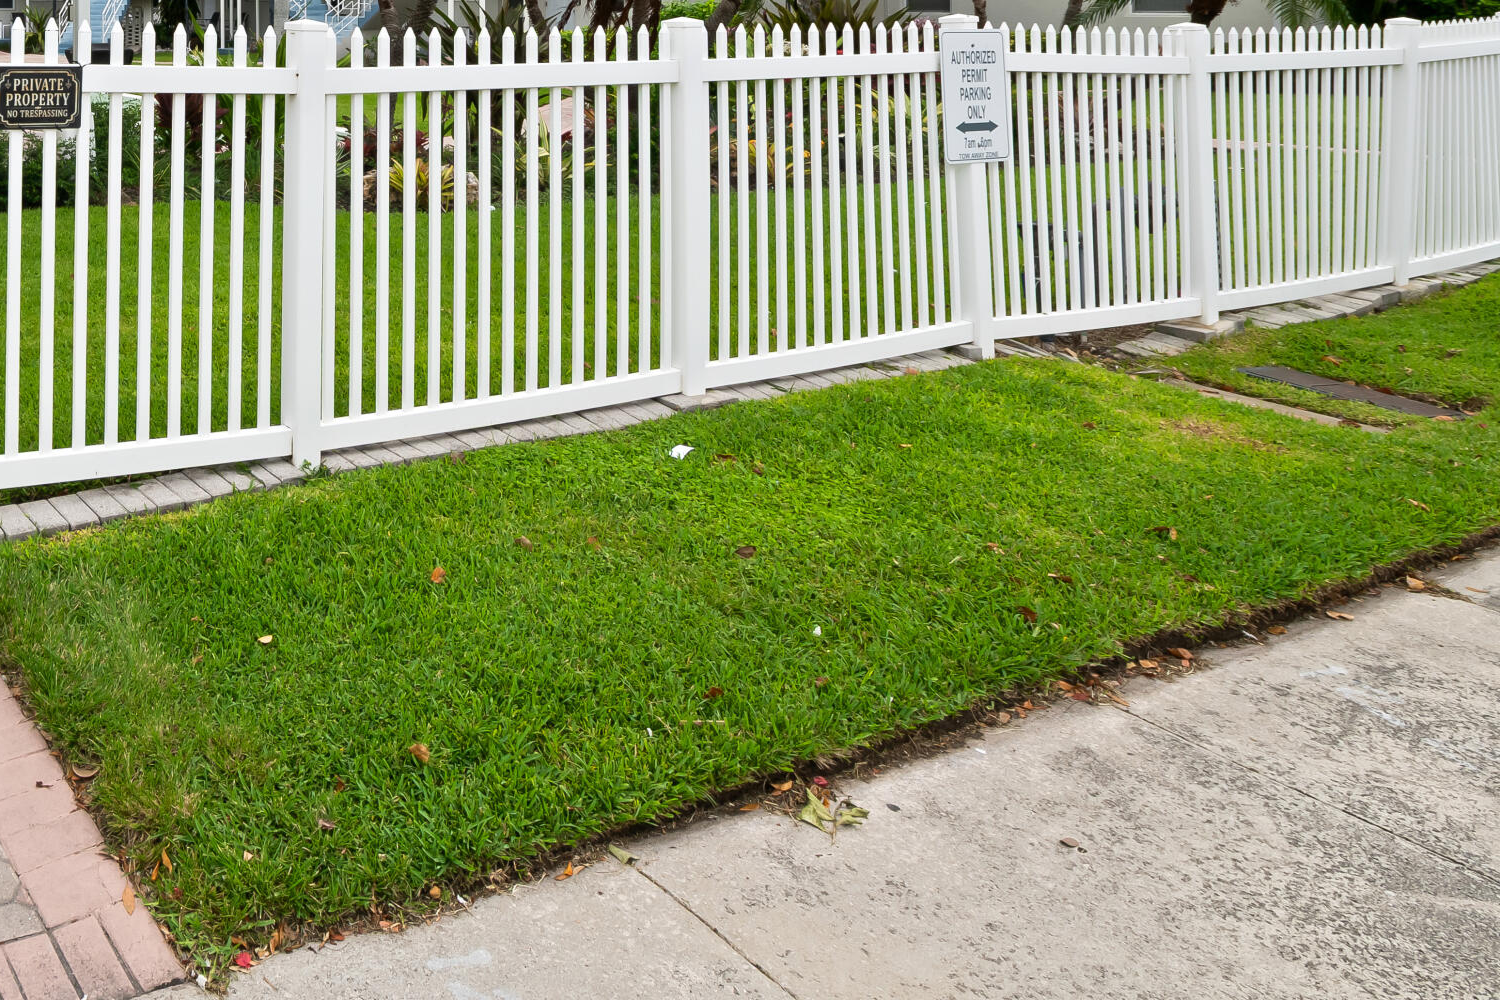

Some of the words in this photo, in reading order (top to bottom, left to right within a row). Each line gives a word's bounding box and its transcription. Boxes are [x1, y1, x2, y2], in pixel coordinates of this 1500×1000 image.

[951, 50, 996, 64] AUTHORIZED
[961, 69, 988, 82] PERMIT
[13, 78, 65, 92] PRIVATE
[5, 92, 70, 106] PROPERTY
[960, 87, 992, 100] PARKING
[6, 109, 18, 118] NO
[20, 108, 68, 118] TRESPASSING
[967, 105, 986, 119] ONLY
